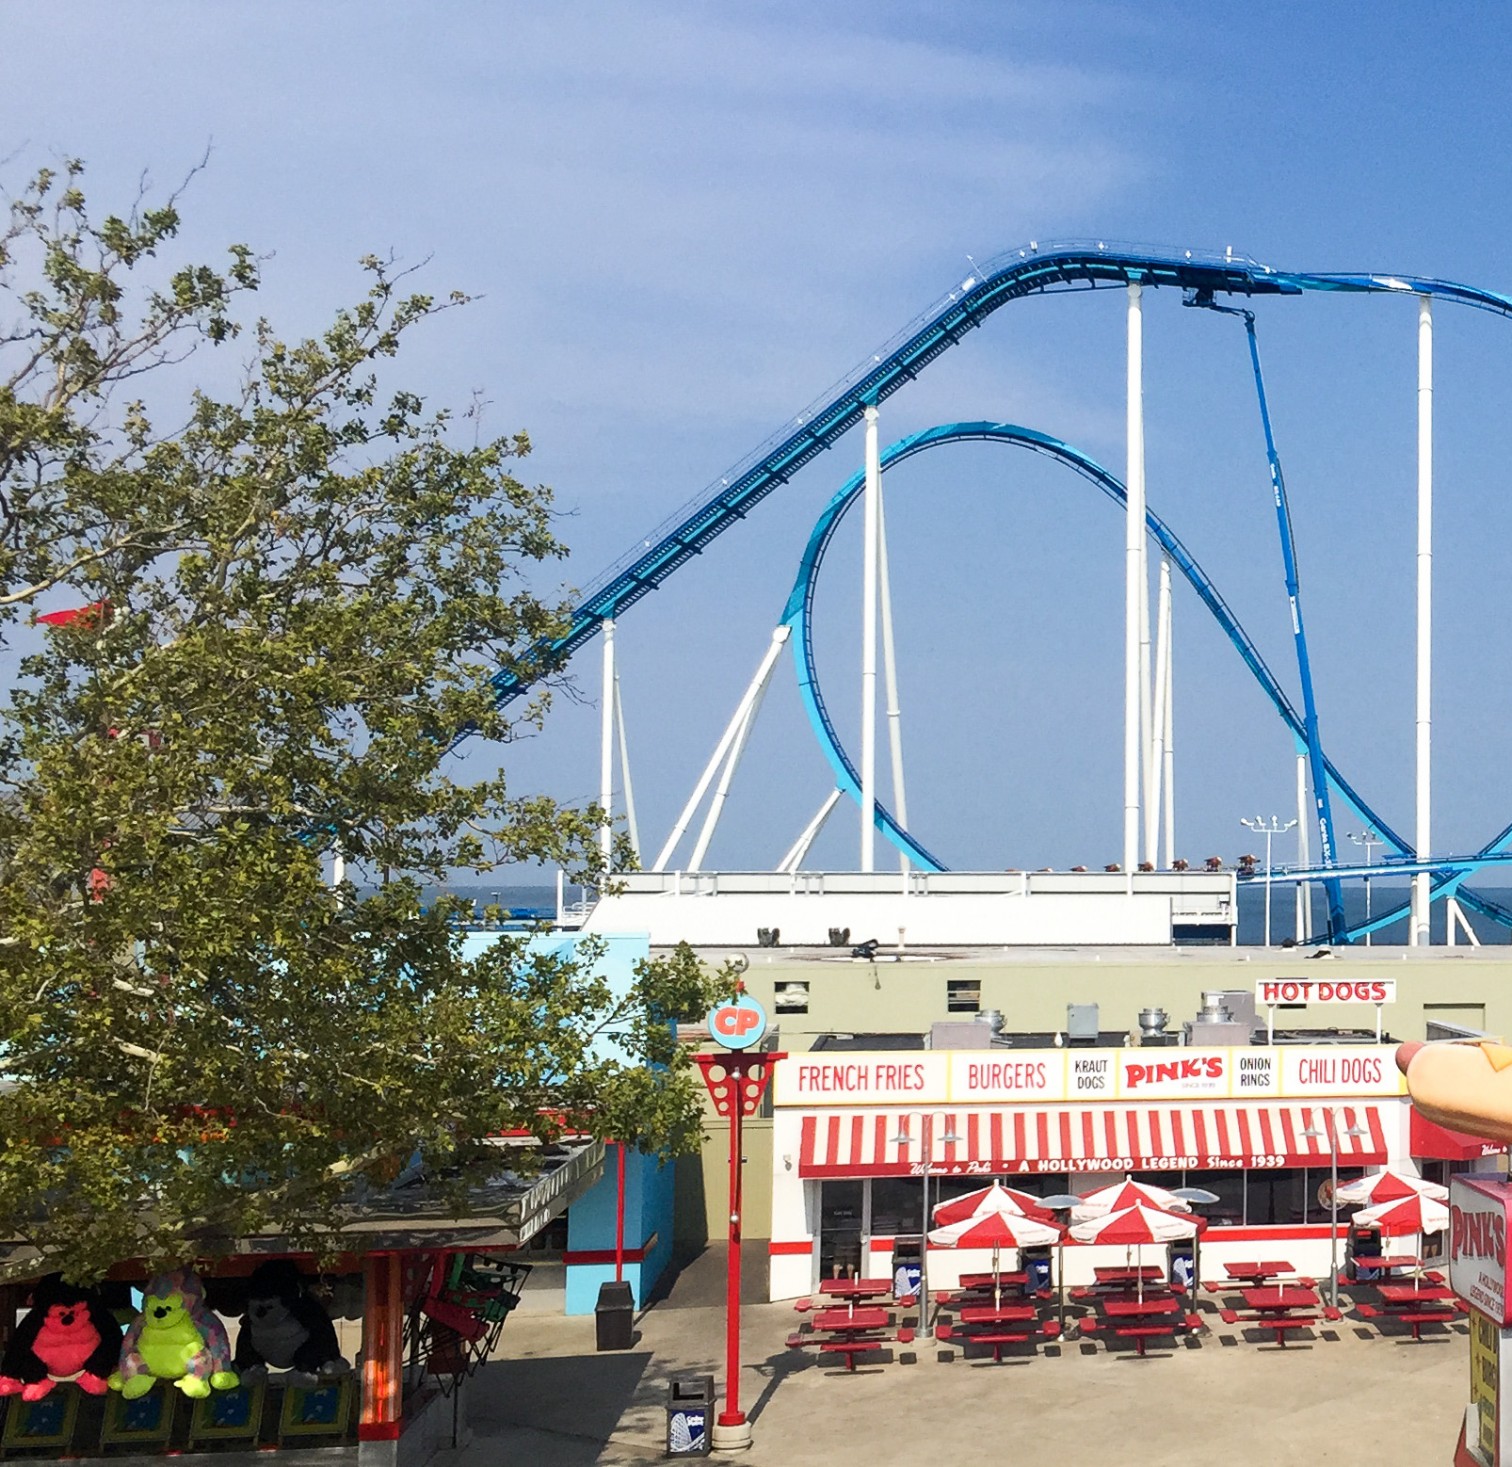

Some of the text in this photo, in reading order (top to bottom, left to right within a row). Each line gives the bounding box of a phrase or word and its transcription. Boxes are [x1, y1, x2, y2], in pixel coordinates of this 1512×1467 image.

[1263, 982, 1387, 1001] HOT DOGS
[714, 1006, 760, 1036] CP
[1074, 1059, 1108, 1074] KRAUT
[1124, 1056, 1223, 1089] PINK'S
[1239, 1057, 1271, 1071] ONION
[1298, 1057, 1382, 1084] CHILI DOGS
[799, 1064, 925, 1092] FRENCH FRIES
[968, 1062, 1046, 1090] BURGERS
[1077, 1075, 1105, 1089] DOGS
[1240, 1073, 1271, 1087] RINGS
[1018, 1155, 1285, 1172] A HOLLYWOOD LEGEND Since 1939
[1451, 1205, 1505, 1268] PINK'S
